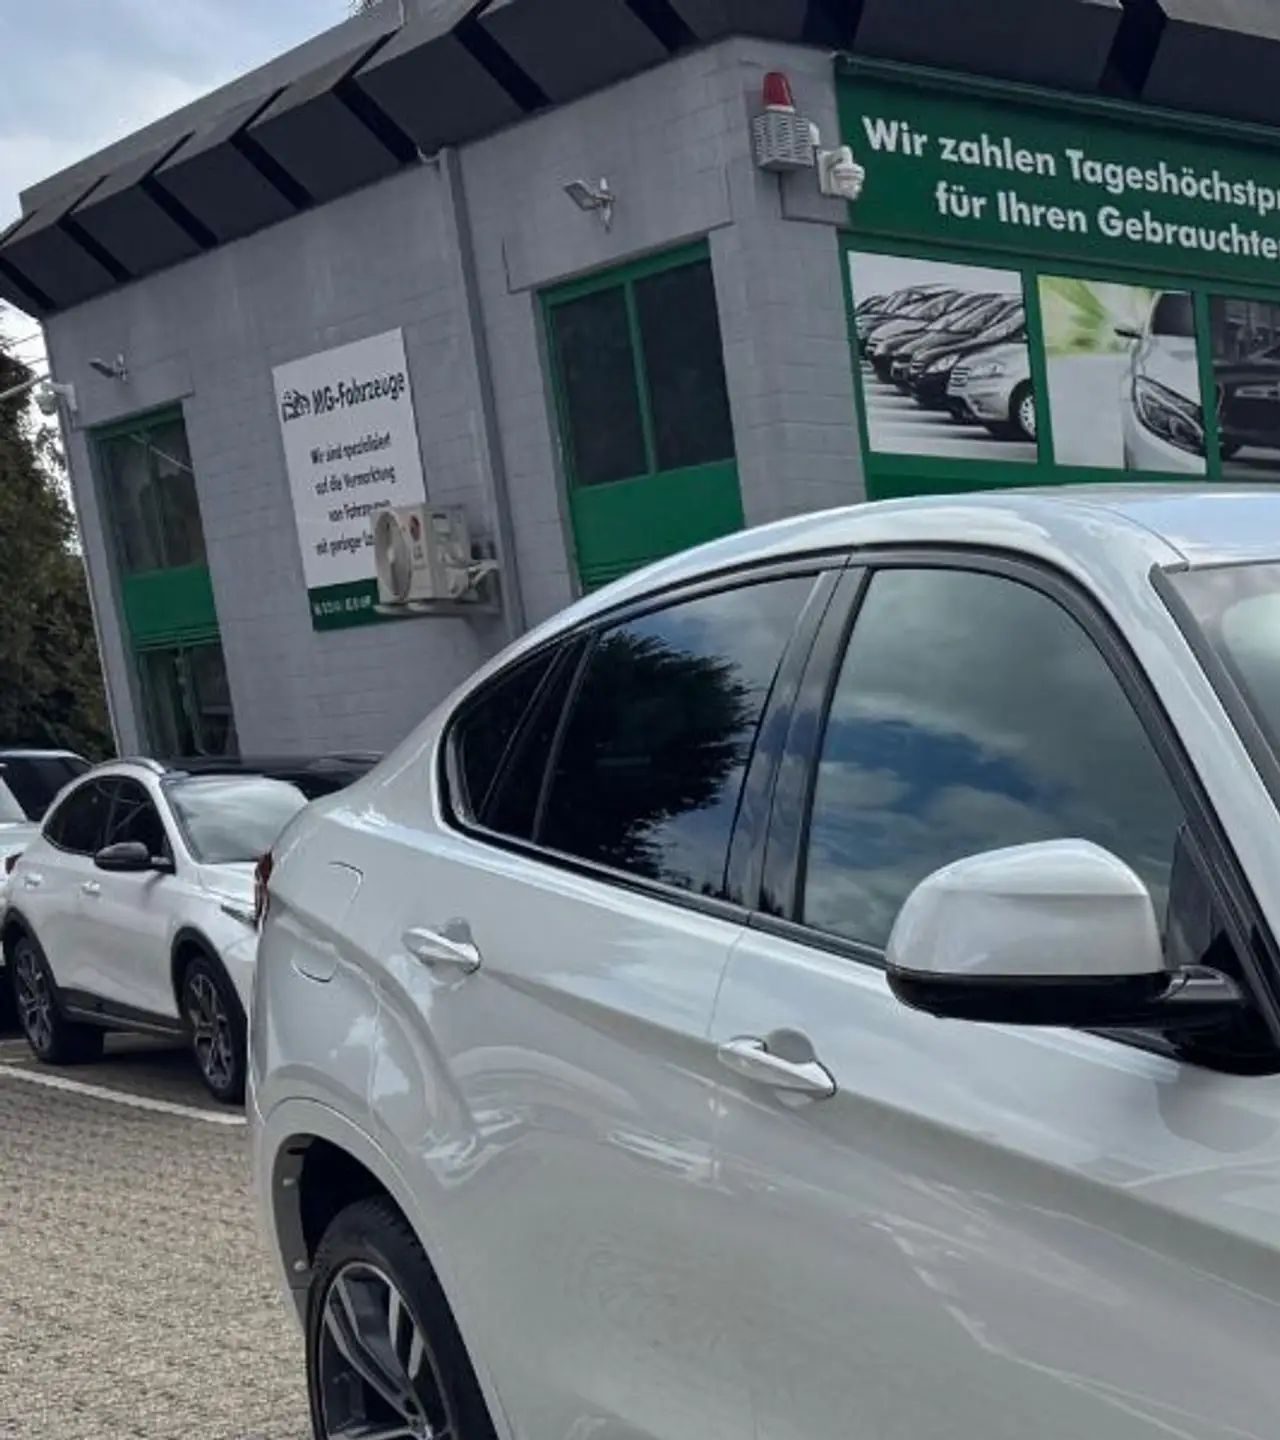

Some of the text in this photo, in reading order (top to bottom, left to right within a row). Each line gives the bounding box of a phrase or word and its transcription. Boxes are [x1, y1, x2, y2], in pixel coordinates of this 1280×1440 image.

[862, 115, 928, 157] Wir
[938, 133, 1057, 177] zahlen
[935, 180, 987, 219] für
[997, 190, 1089, 234] Ihren
[312, 372, 404, 415] MG-Fahrzeuge
